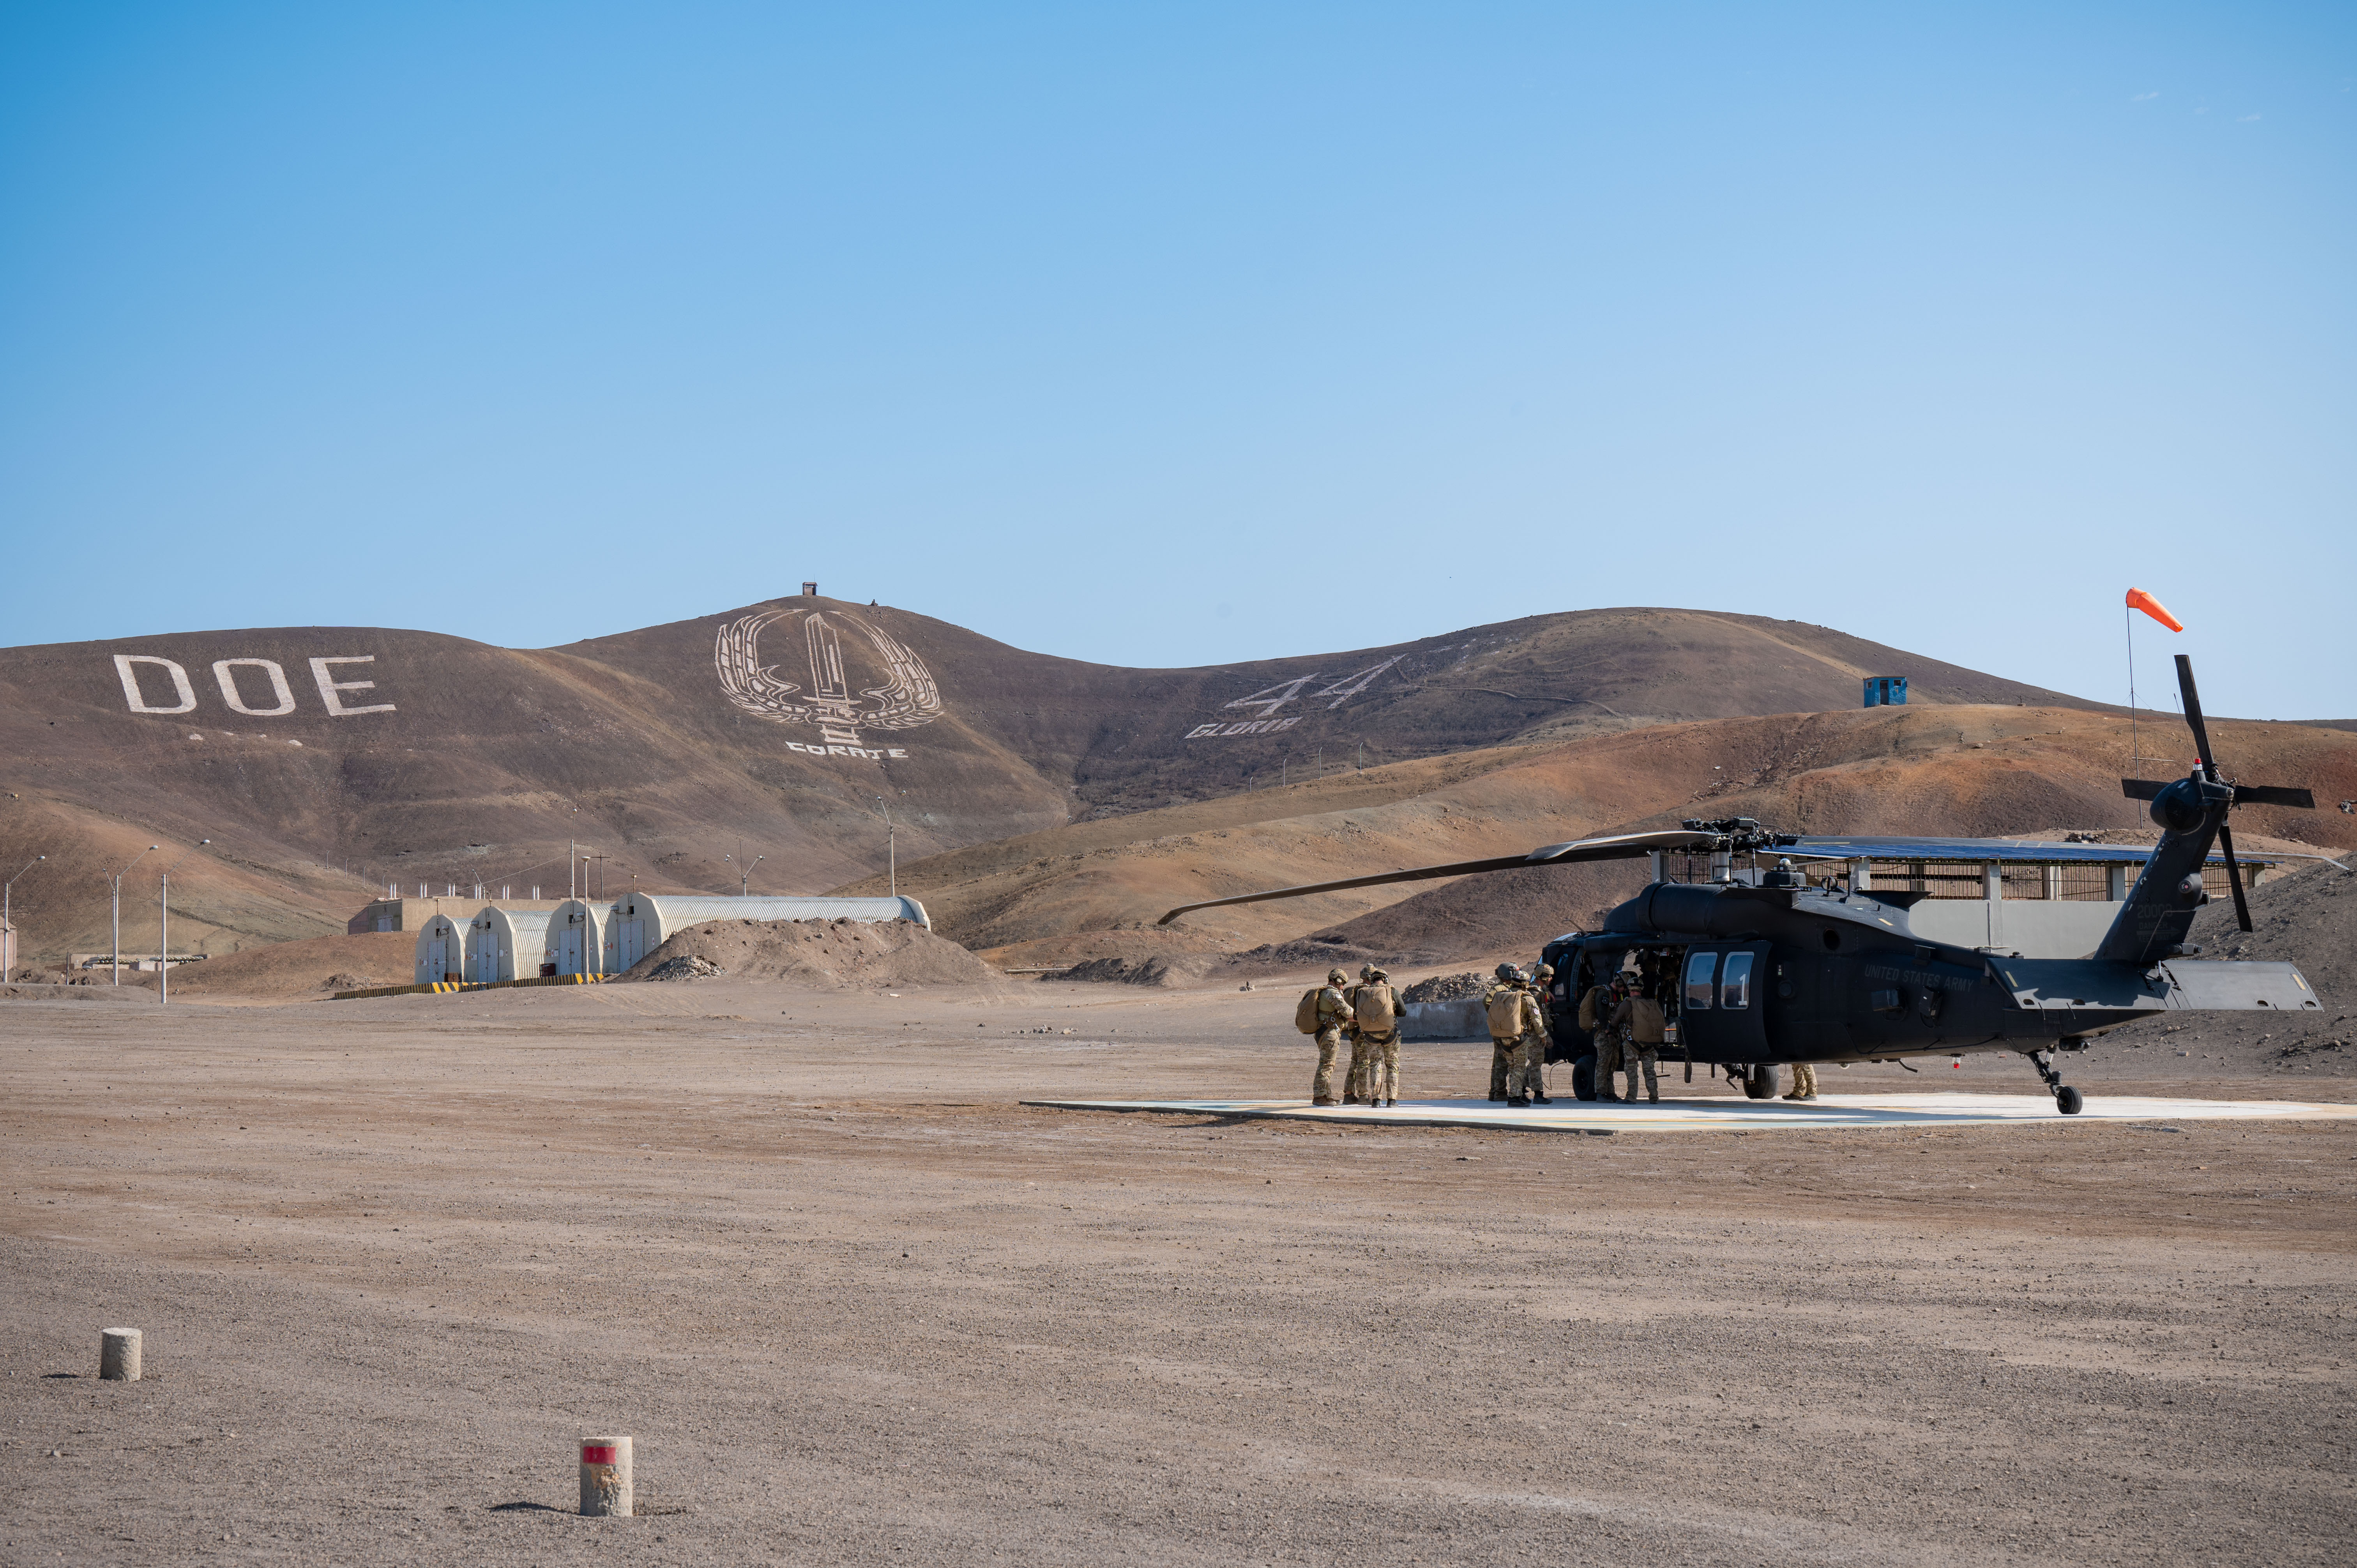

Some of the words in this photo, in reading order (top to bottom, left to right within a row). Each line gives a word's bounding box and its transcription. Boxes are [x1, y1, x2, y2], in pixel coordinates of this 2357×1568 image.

[113, 655, 398, 716] DOE
[1223, 653, 1409, 718] 44
[1183, 716, 1303, 740] GLORIA
[1738, 974, 1747, 1006] 1
[1865, 964, 1899, 981] UNITED
[1903, 970, 1940, 987] STATES
[1944, 976, 1974, 992] ARMY
